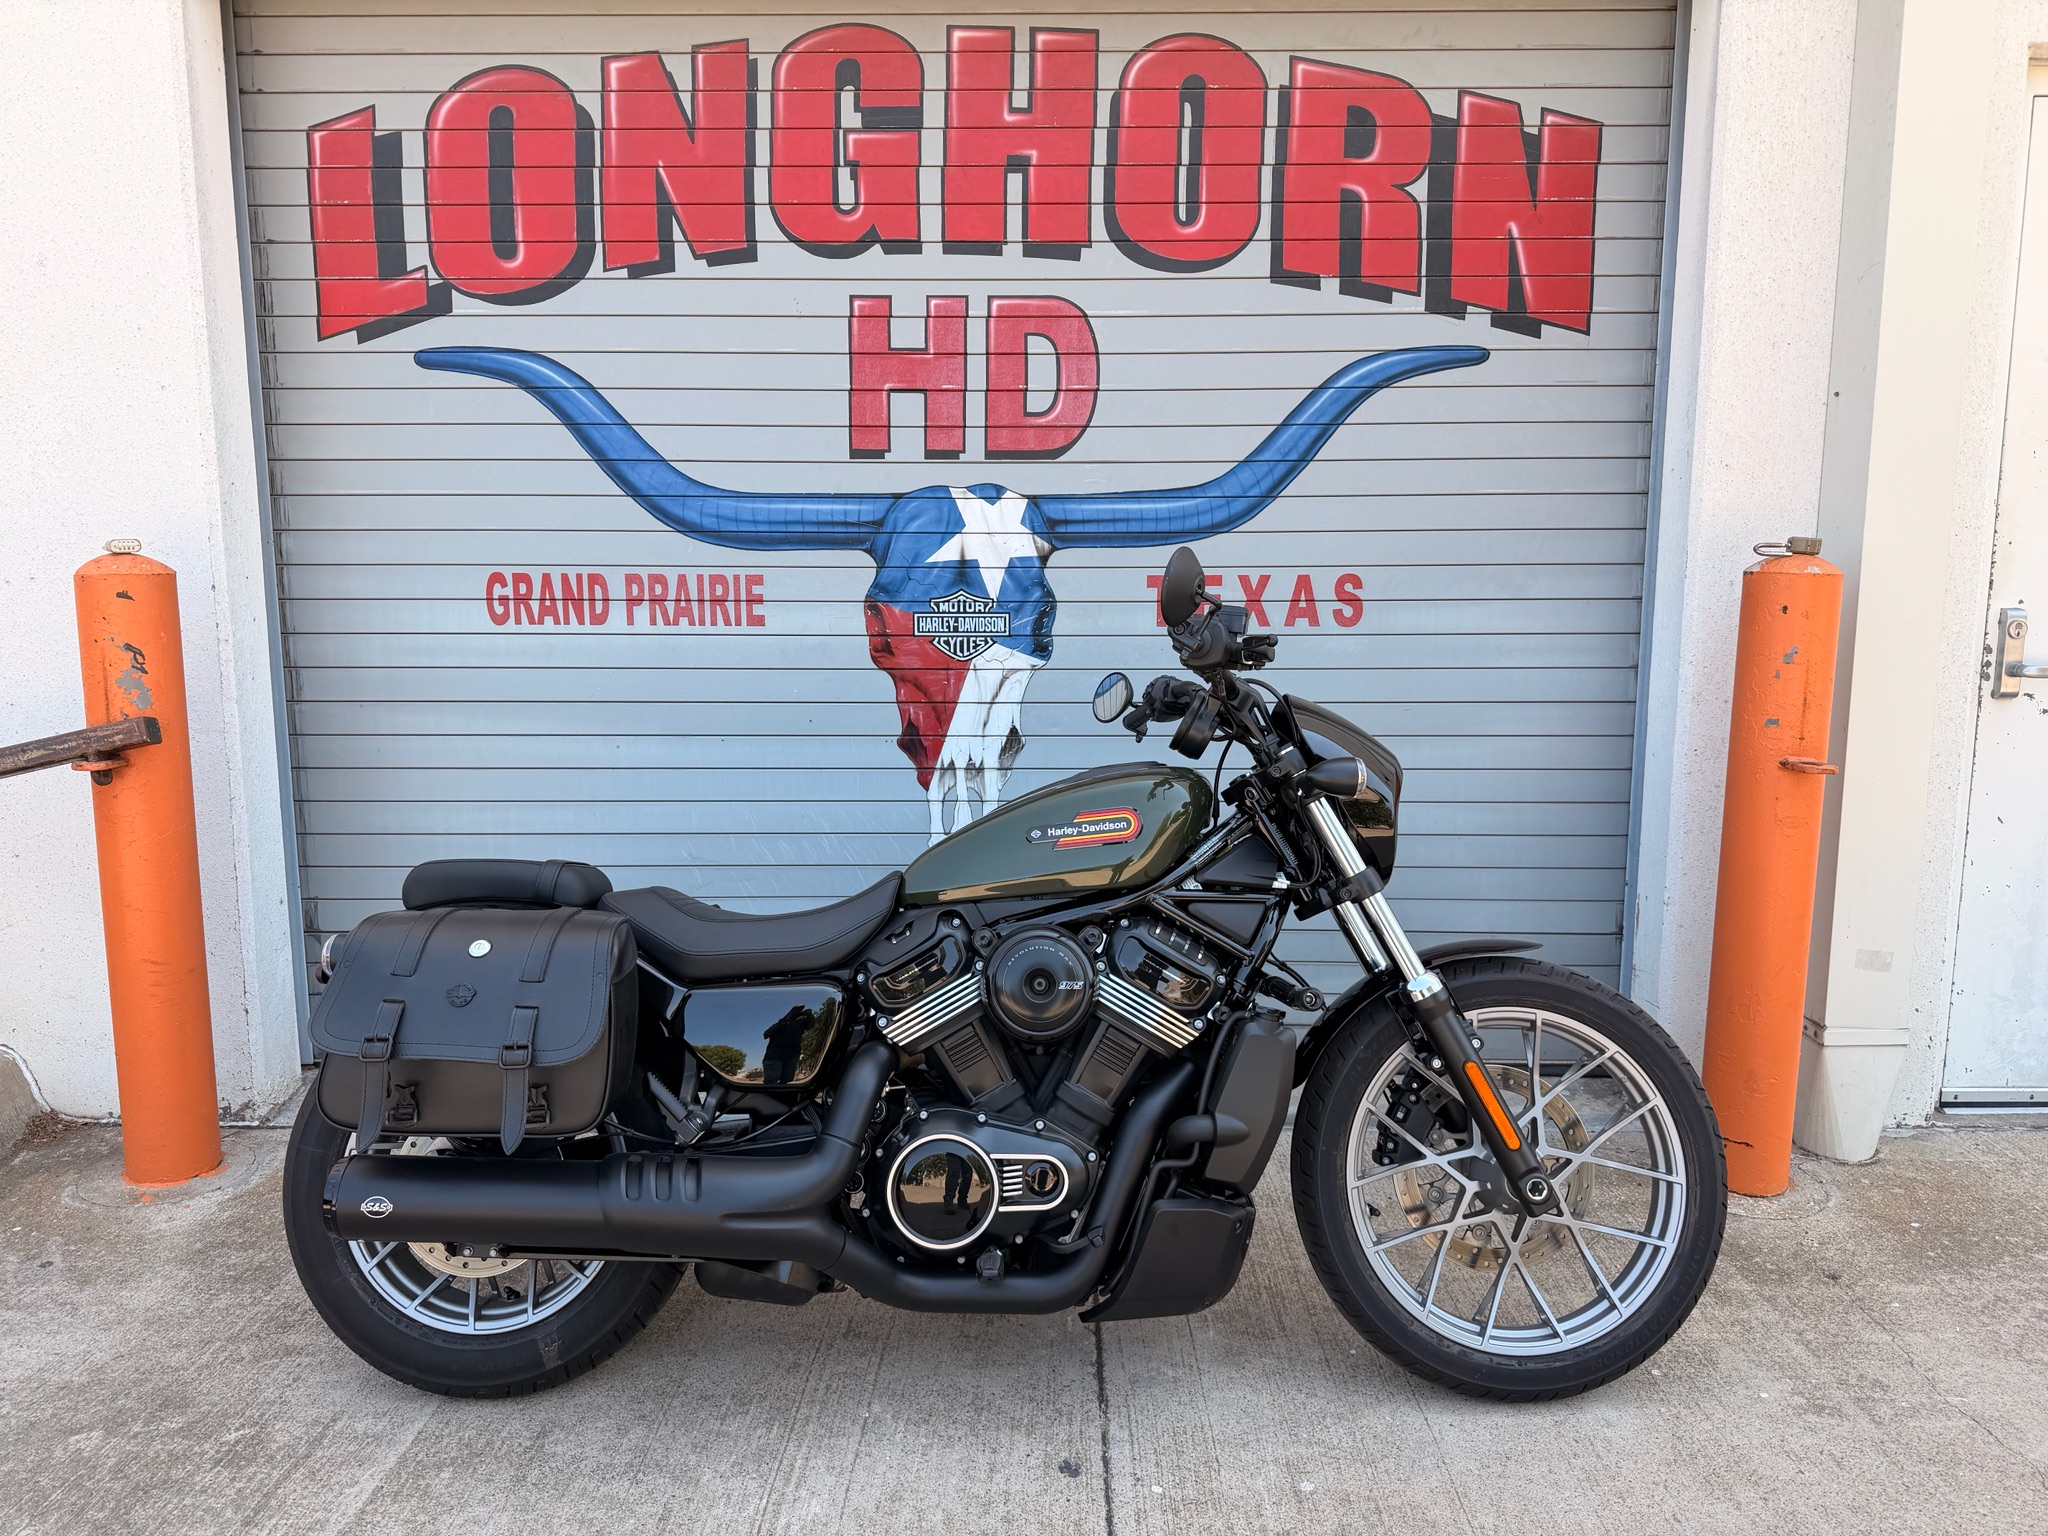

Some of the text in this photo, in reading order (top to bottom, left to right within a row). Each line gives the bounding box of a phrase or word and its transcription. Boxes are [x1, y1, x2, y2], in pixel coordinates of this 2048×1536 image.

[307, 23, 1603, 343] LONGHORN
[849, 294, 1100, 460] HD
[485, 571, 766, 627] GRAND PRAIRIE
[939, 600, 985, 613] MOTOR
[918, 614, 1006, 634] HARLEY-DAVIDSON
[939, 636, 986, 657] CYCLES
[1047, 821, 1128, 837] Harley-Davidson
[365, 1202, 388, 1212] S&S
